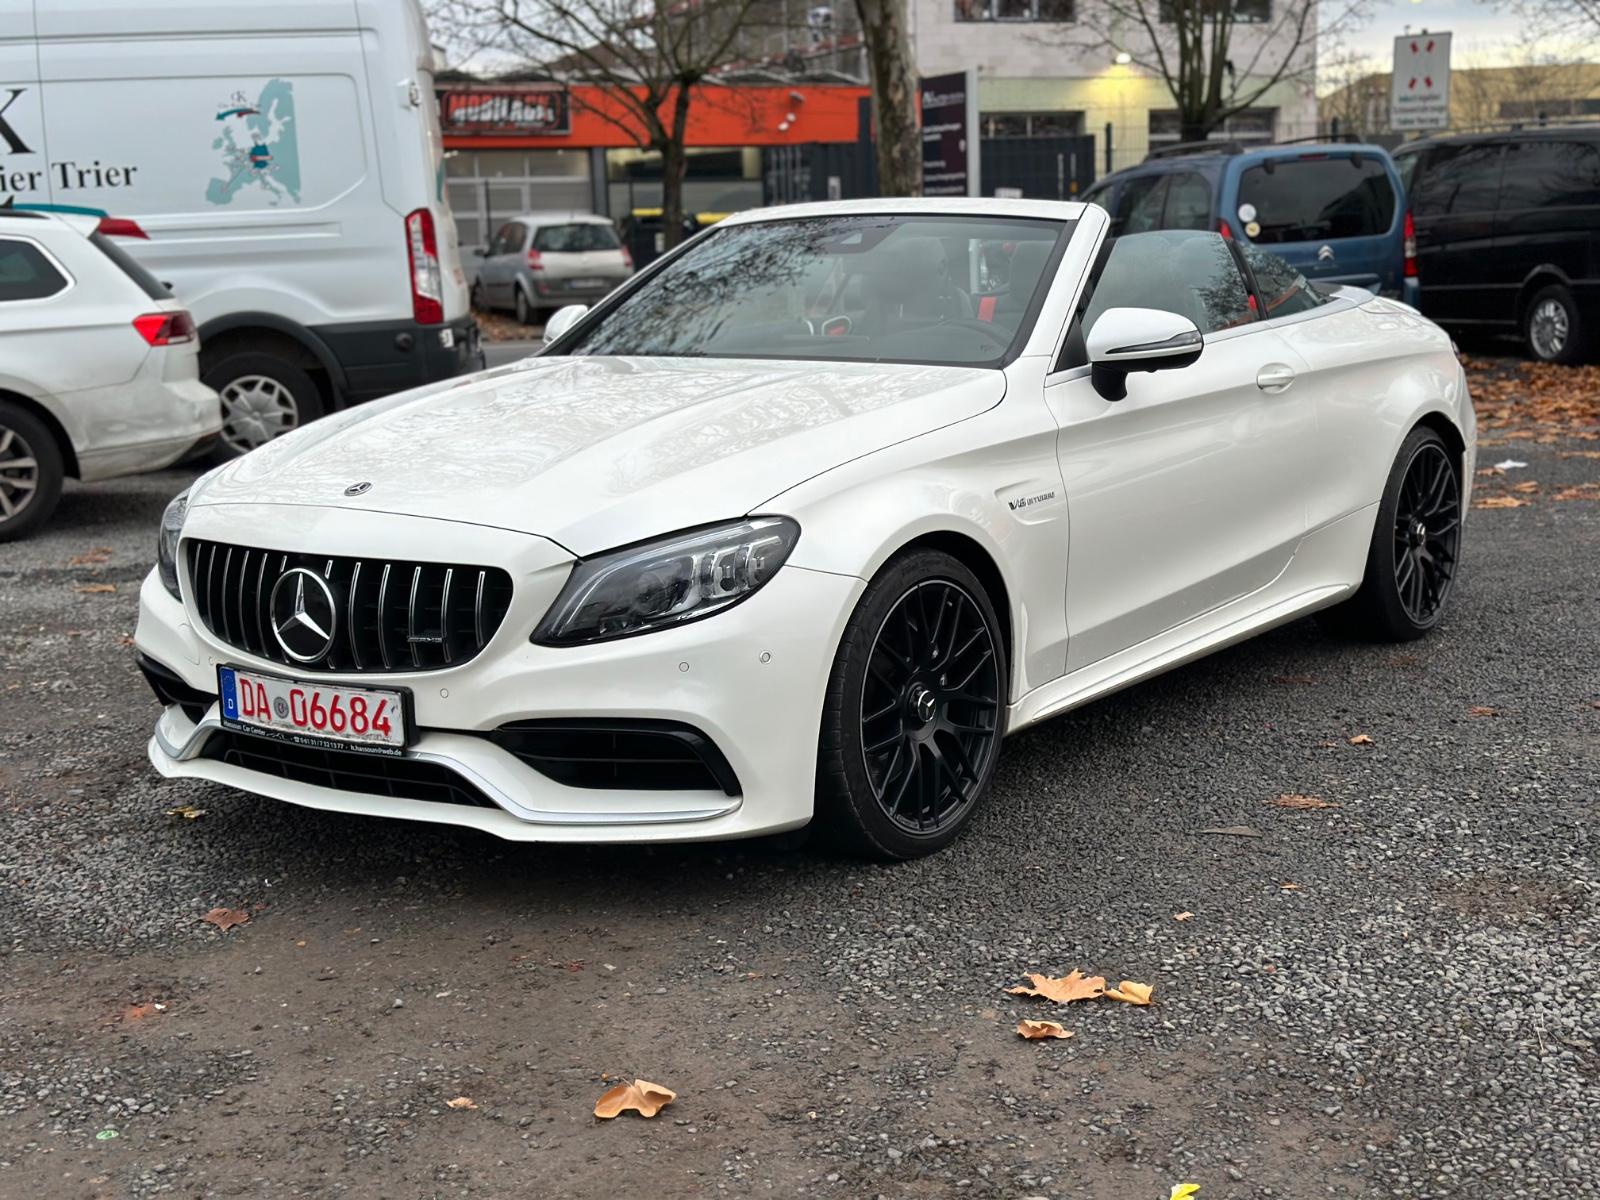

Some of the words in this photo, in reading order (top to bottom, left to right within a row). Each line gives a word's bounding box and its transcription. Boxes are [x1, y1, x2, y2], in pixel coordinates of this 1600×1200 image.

[51, 160, 138, 190] Trier
[240, 678, 271, 721] DA
[289, 688, 391, 736] 06684
